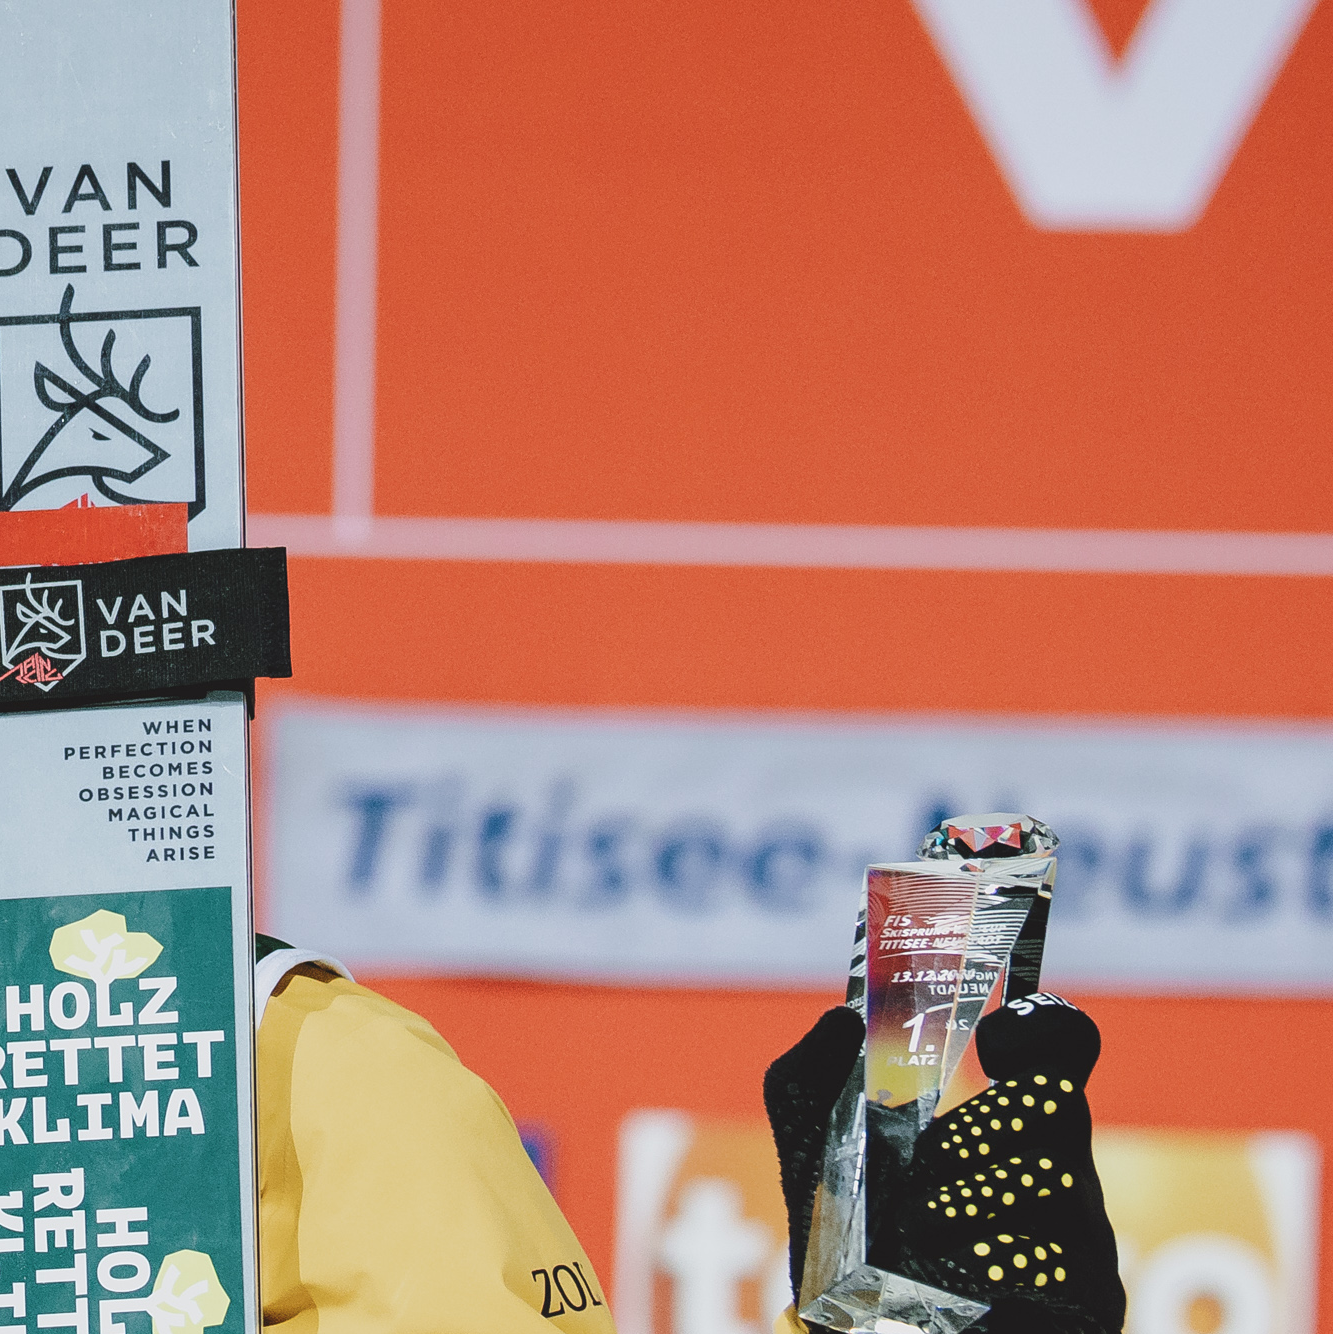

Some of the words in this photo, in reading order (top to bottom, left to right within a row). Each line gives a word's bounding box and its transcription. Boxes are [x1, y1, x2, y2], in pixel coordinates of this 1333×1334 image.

[5, 160, 171, 216] VAN
[96, 589, 187, 625] VAN
[100, 619, 216, 658] DEER
[143, 718, 212, 736] WHEN
[63, 740, 213, 761] PERFECTION
[102, 761, 214, 780] BECOMES
[78, 782, 214, 803] OBSESSION
[108, 803, 215, 822] MAGICAL
[128, 824, 215, 842] THINGS
[145, 845, 216, 863] ARISE
[5, 976, 179, 1033] HOLZ
[887, 1054, 939, 1067] PLATZ
